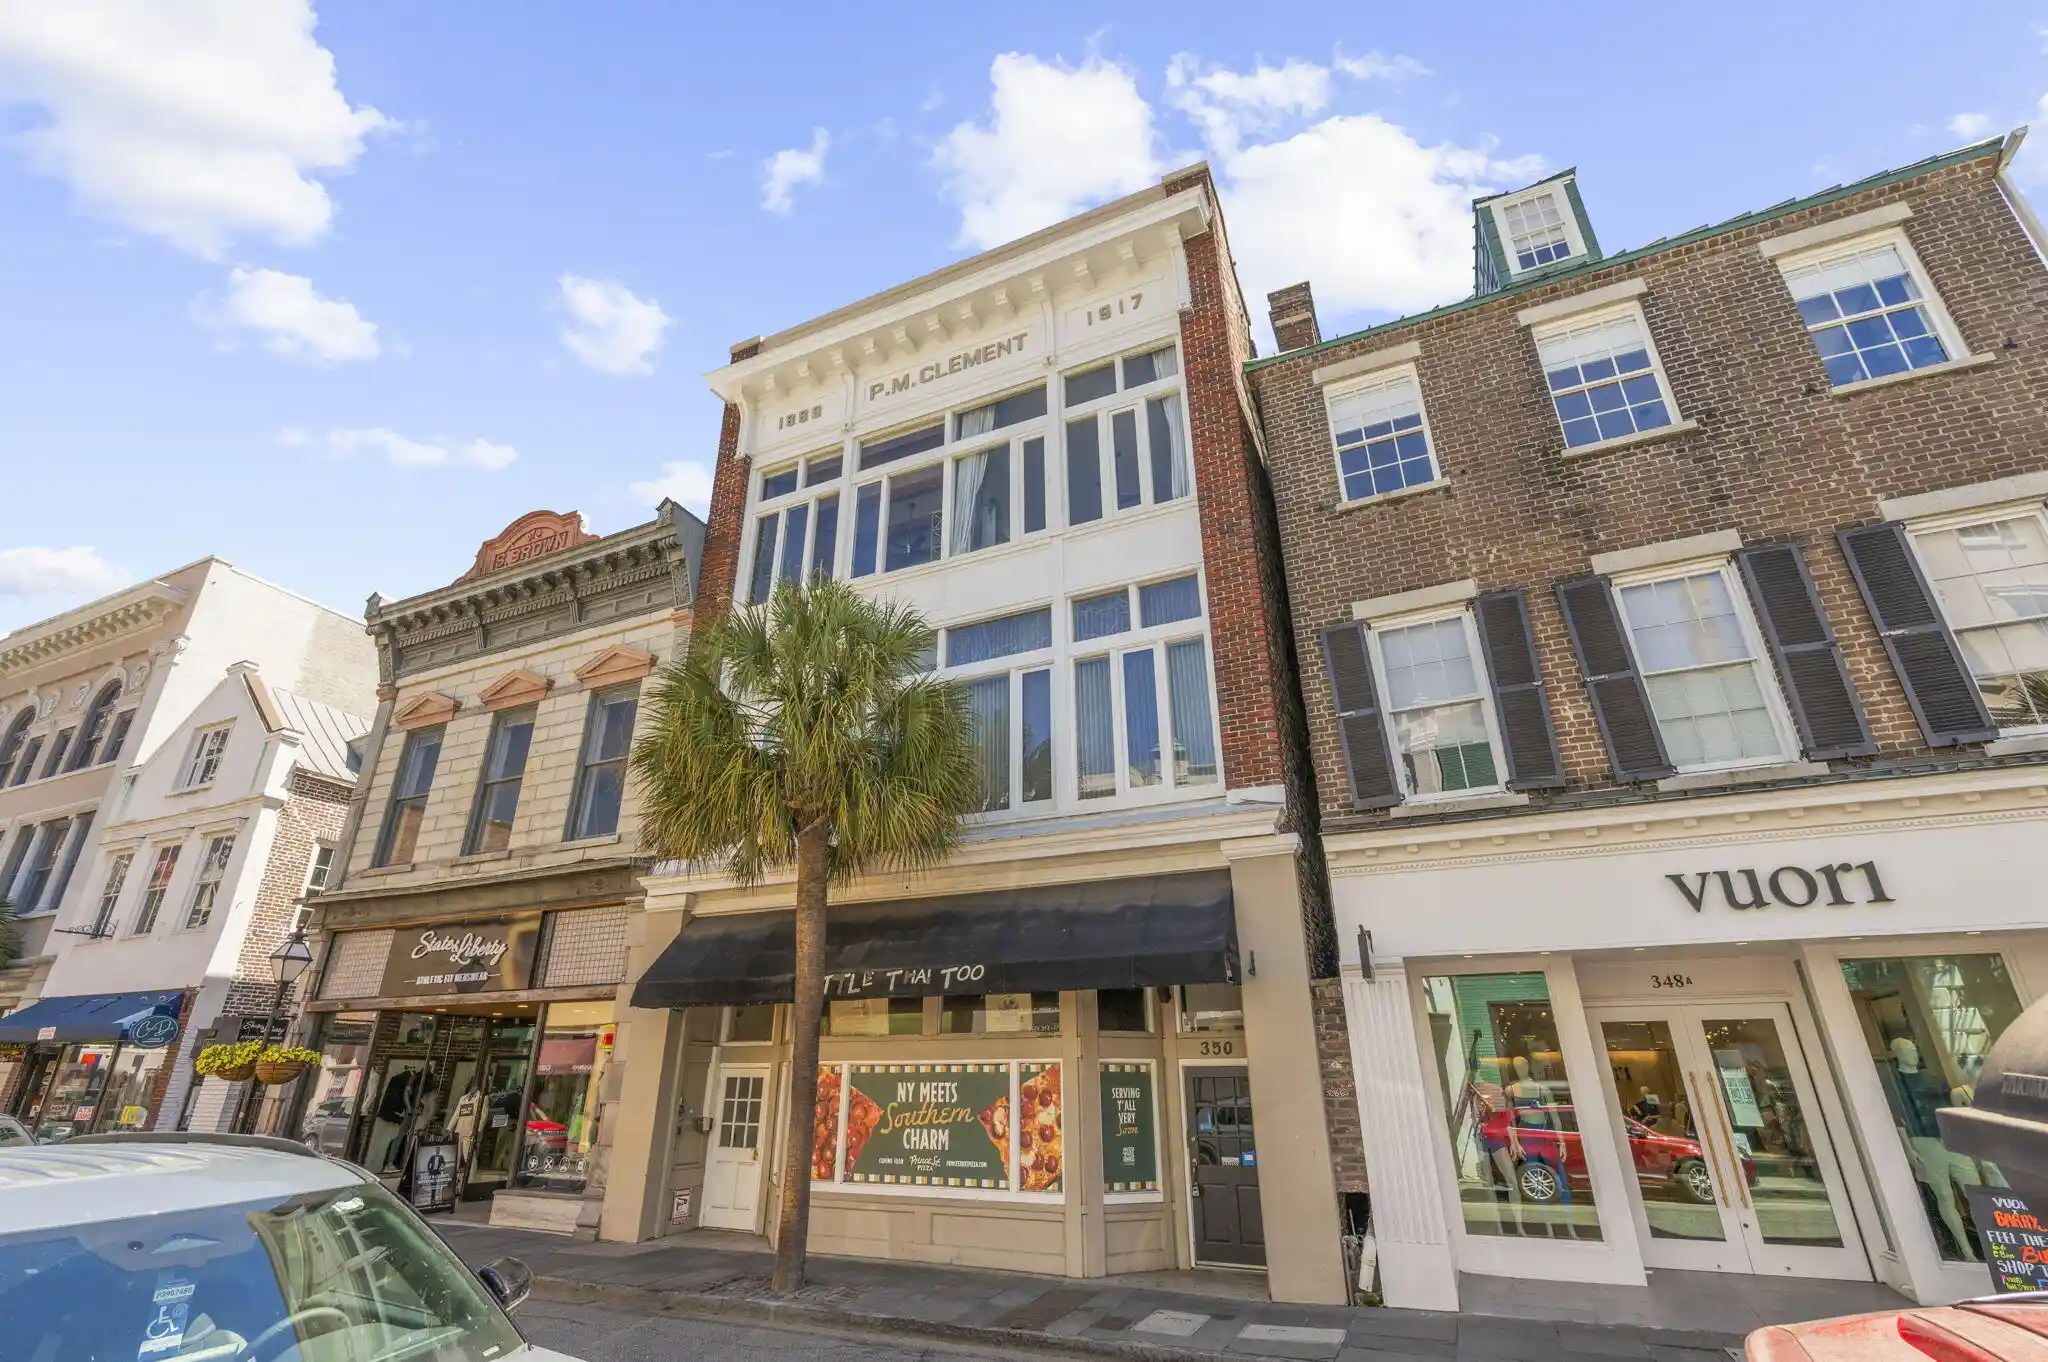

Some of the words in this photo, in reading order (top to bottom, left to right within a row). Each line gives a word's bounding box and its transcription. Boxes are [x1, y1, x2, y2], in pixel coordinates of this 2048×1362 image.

[1087, 292, 1143, 326] 1917
[778, 404, 823, 430] 1889
[510, 530, 569, 563] BROWN
[1664, 860, 1897, 914] vuori
[411, 930, 455, 959] State
[450, 932, 511, 966] Liberty
[823, 970, 875, 995] TTLE
[886, 968, 931, 992] THAI
[940, 964, 985, 990] TOO
[1200, 1041, 1233, 1056] 350
[897, 1081, 915, 1102] NY
[920, 1081, 958, 1103] MEETS
[1111, 1087, 1140, 1099] SERVING
[1117, 1099, 1137, 1111] Y'ALL
[880, 1100, 974, 1134] Southern
[1118, 1112, 1136, 1124] VERY
[902, 1128, 949, 1151] CHARM
[1115, 1122, 1140, 1137] Soon
[1986, 1230, 2018, 1244] FEEL
[1997, 1260, 2035, 1276] SHOP
